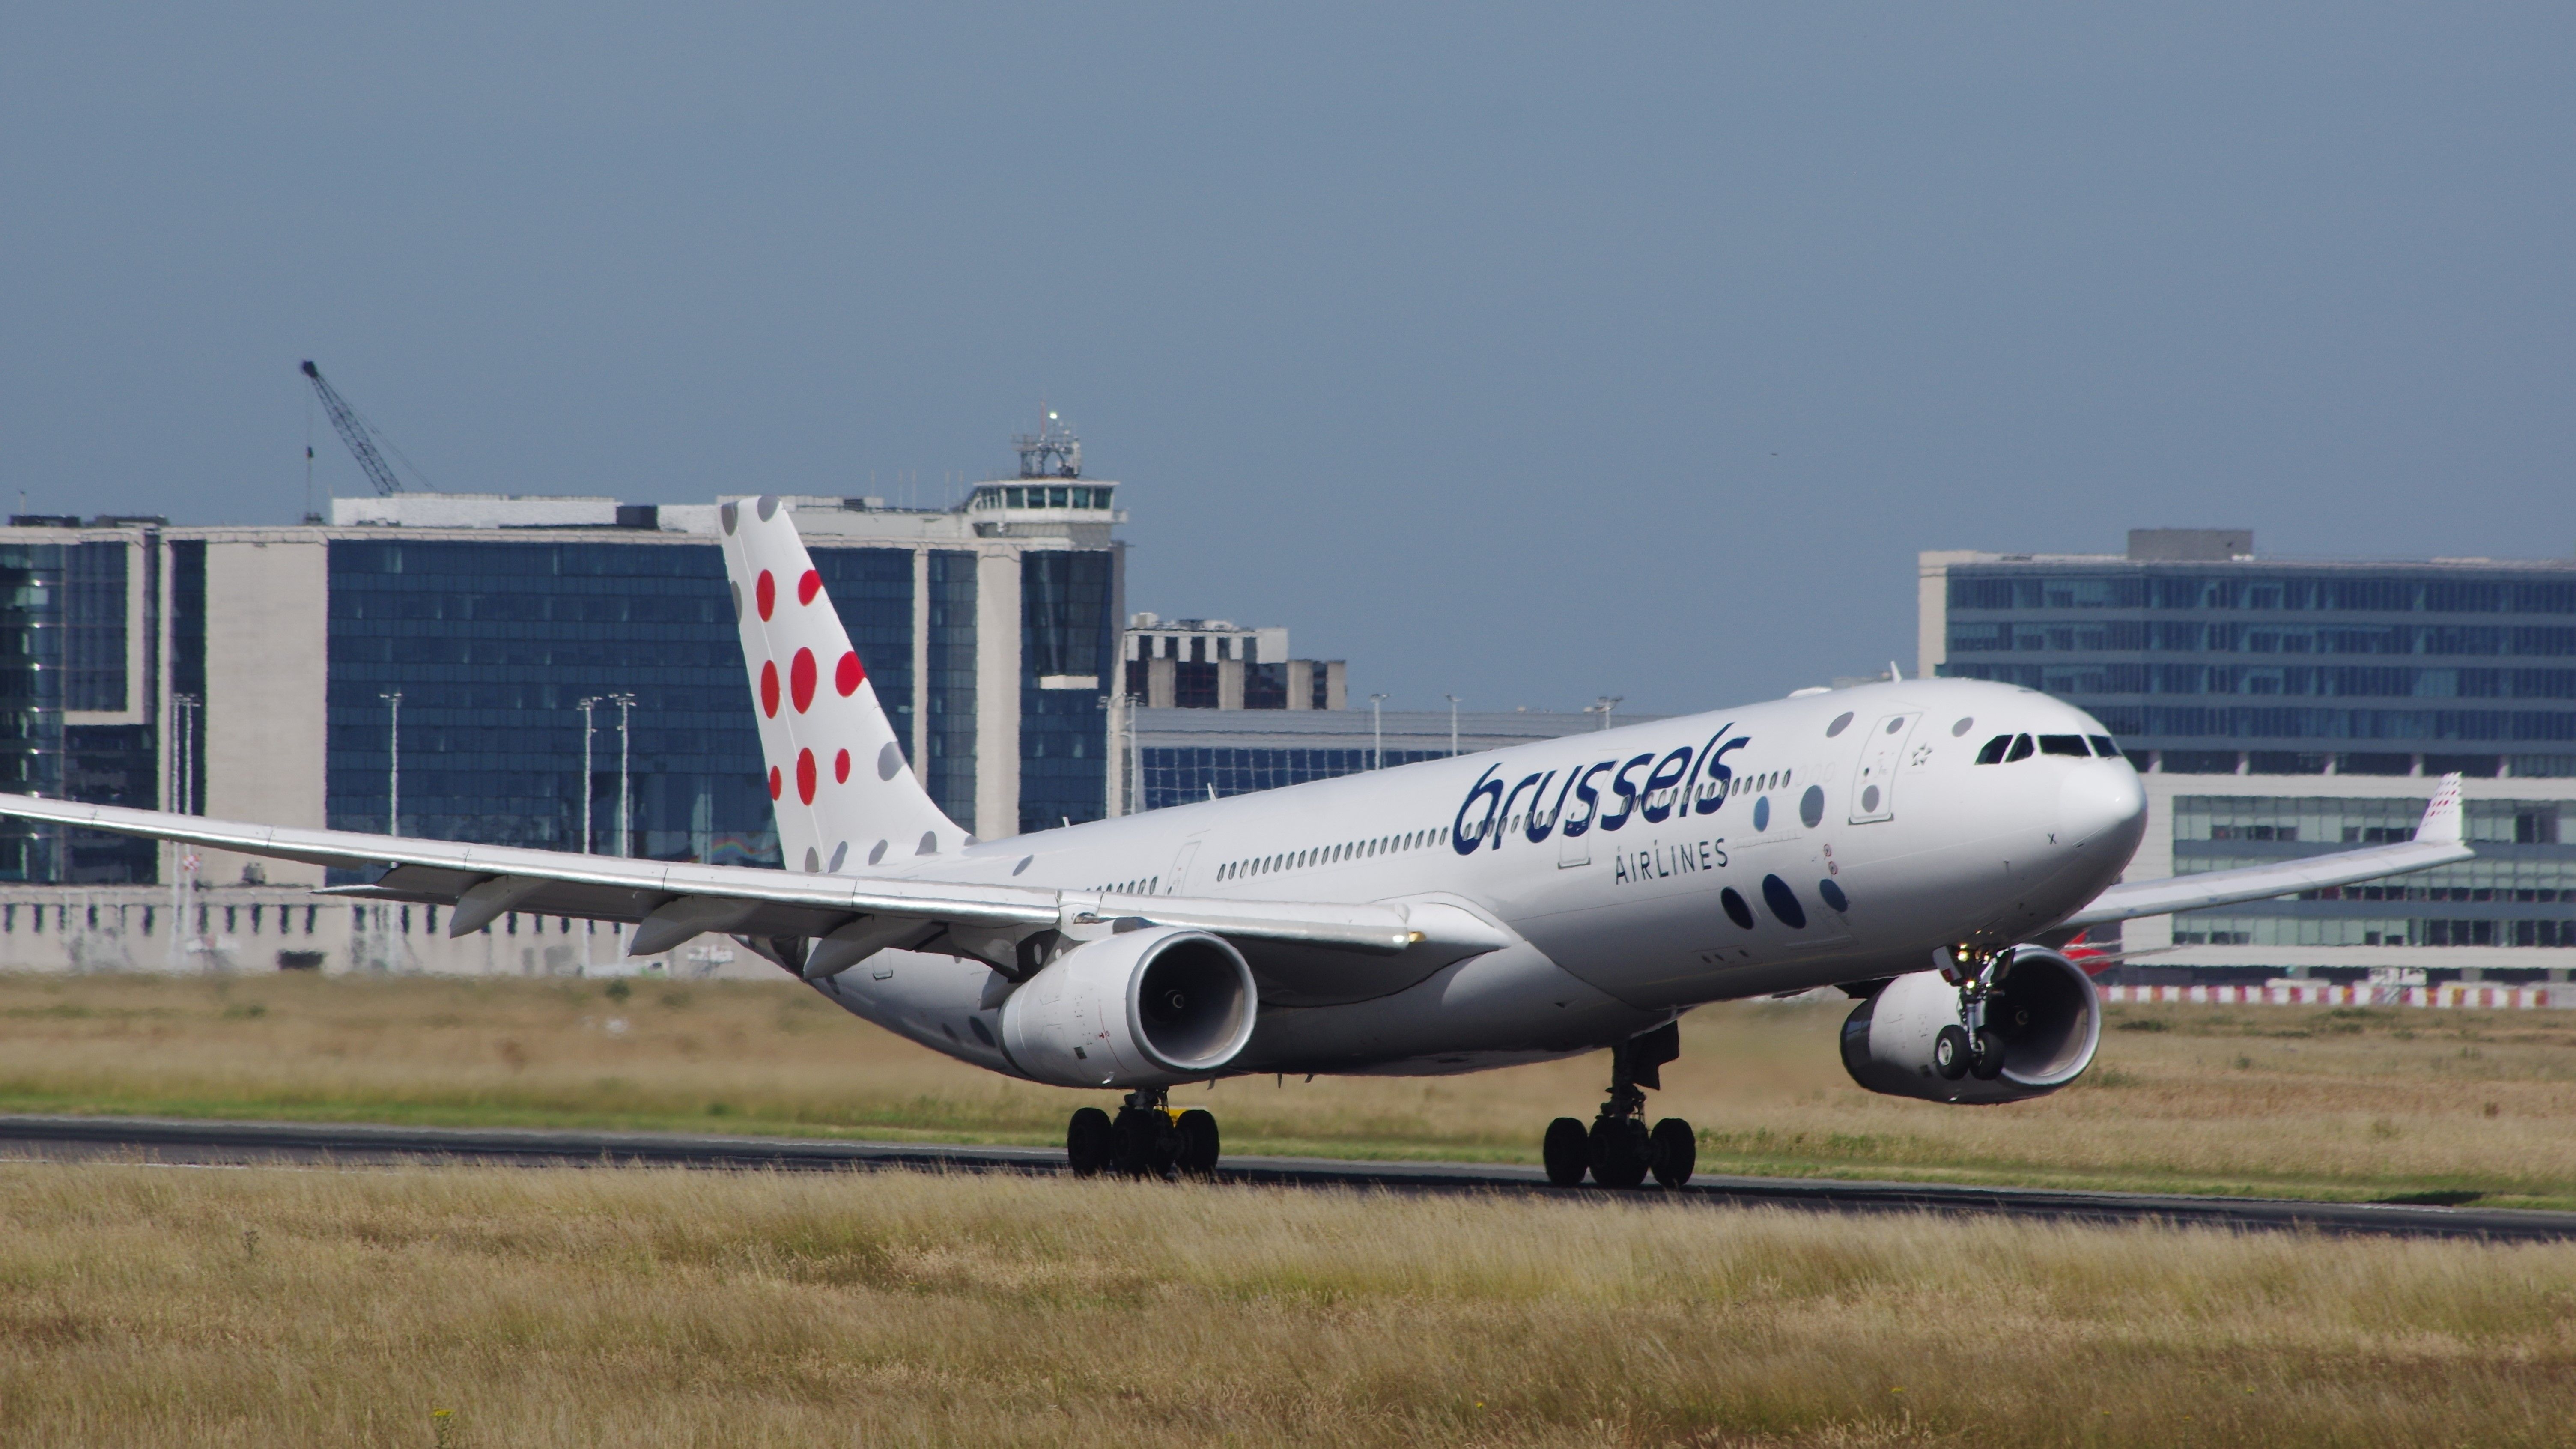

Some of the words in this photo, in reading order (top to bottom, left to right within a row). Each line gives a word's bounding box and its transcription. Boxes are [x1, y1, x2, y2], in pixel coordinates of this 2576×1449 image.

[1452, 722, 1752, 856] brussels
[1616, 838, 1728, 885] AIRLINES
[2048, 833, 2057, 845] X
